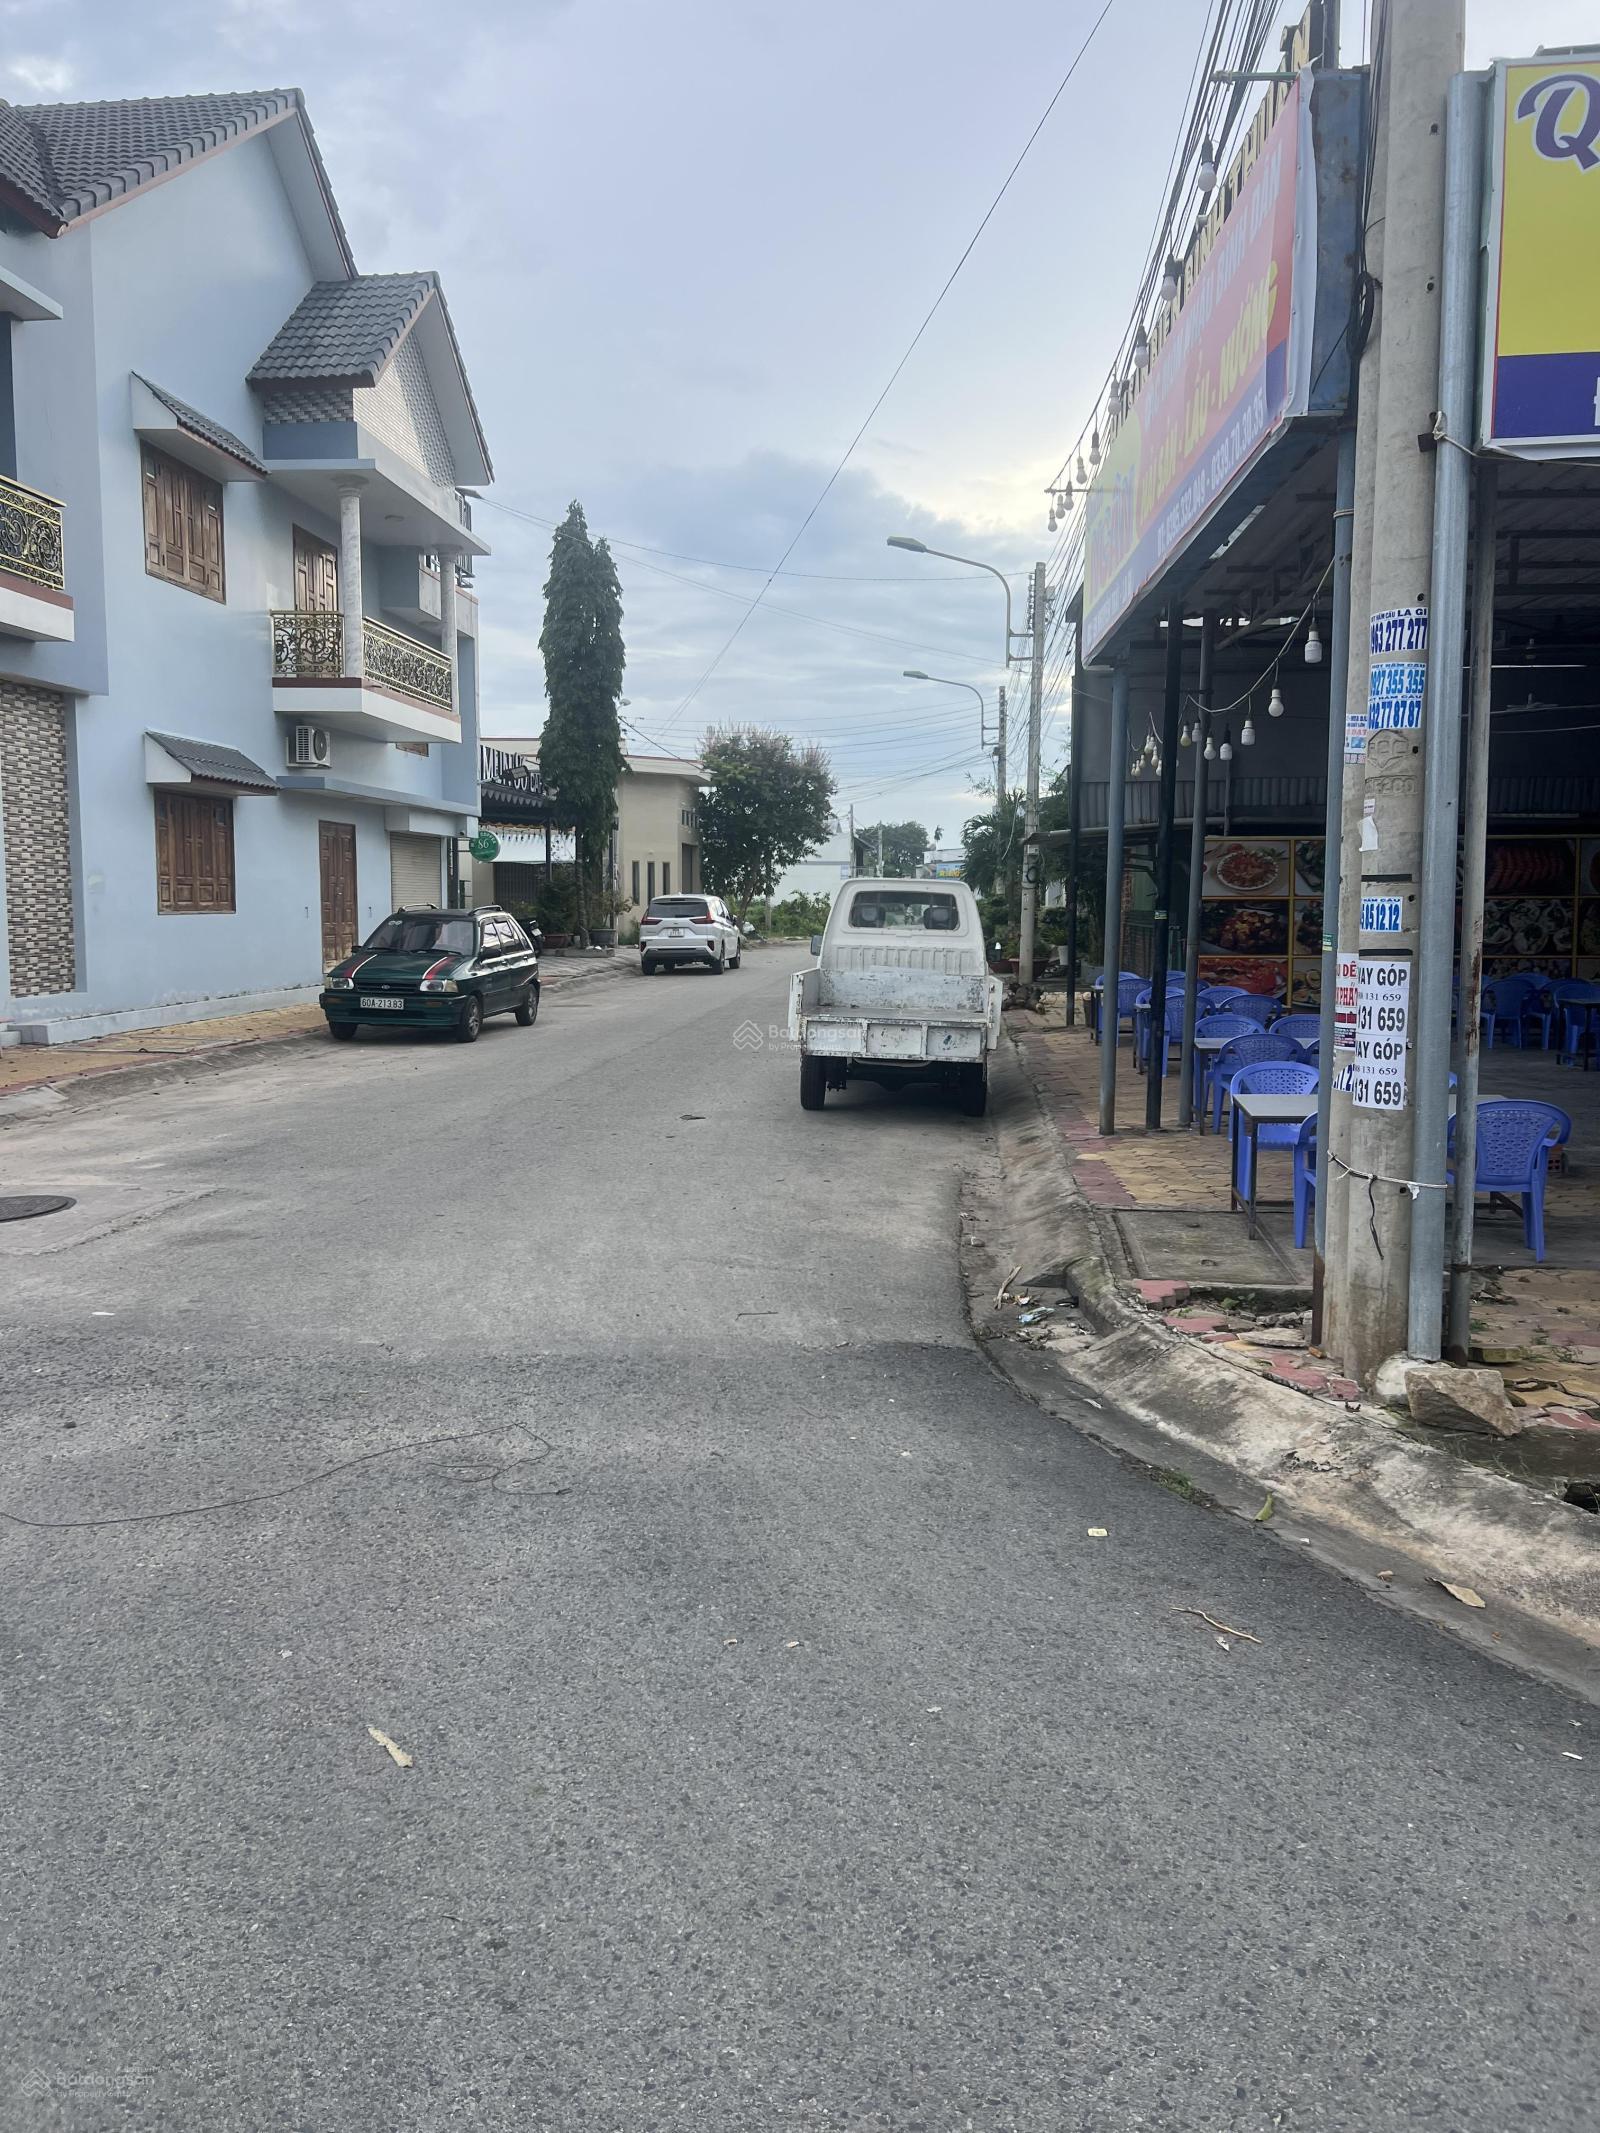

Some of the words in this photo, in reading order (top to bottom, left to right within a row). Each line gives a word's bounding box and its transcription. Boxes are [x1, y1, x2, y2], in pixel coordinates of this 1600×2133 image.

[1397, 608, 1412, 617] LA
[1415, 607, 1427, 616] GI
[1377, 963, 1408, 987] GÓP
[1382, 993, 1402, 1002] 659
[1378, 1006, 1406, 1033] 659
[1373, 1037, 1404, 1061] GÓP
[1378, 1067, 1398, 1076] 659
[1374, 1080, 1403, 1106] 659
